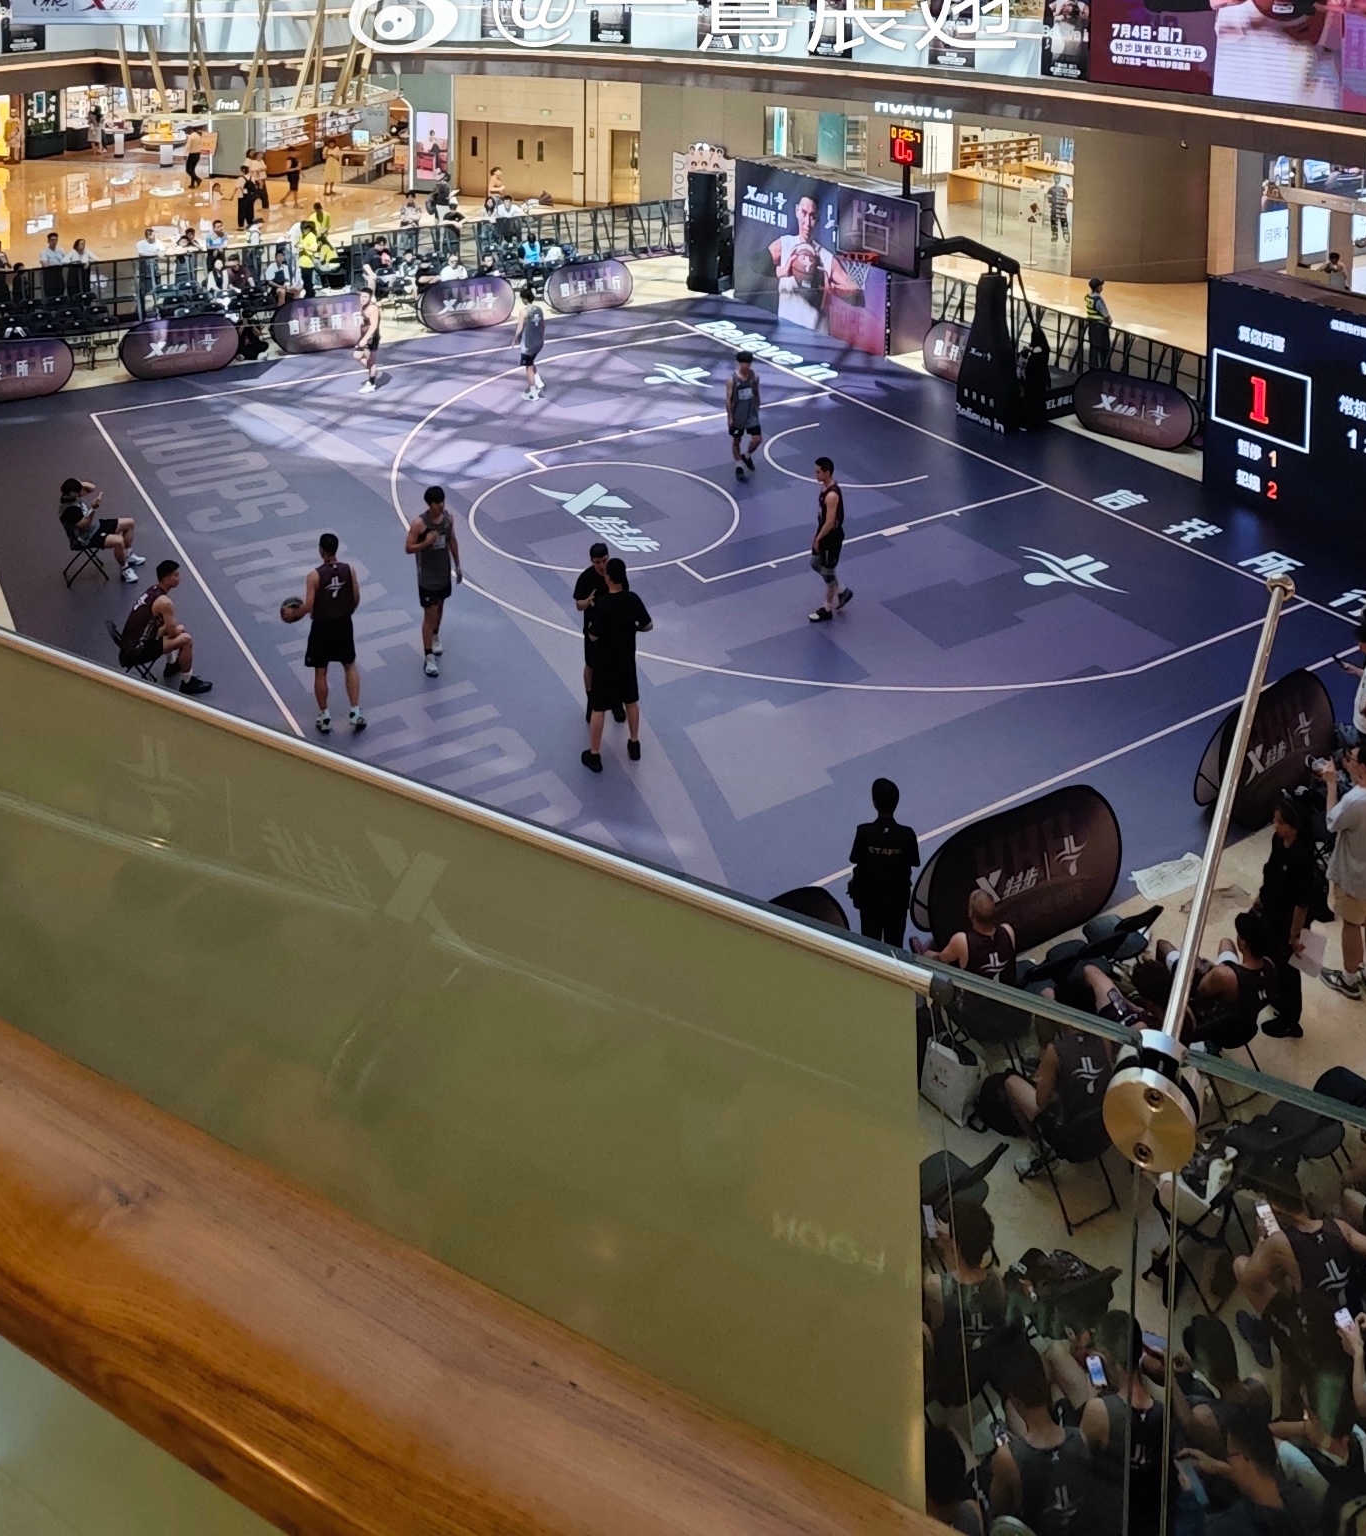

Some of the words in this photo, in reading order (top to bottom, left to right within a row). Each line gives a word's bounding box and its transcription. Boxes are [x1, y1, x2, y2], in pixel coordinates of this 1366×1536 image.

[215, 99, 240, 111] fresh
[742, 202, 776, 225] BELIEVE
[695, 320, 804, 364] Believe
[793, 362, 839, 382] in
[1250, 375, 1269, 425] 1
[1268, 449, 1277, 468] 1
[1236, 468, 1261, 493] 犯规
[1267, 480, 1278, 500] 2
